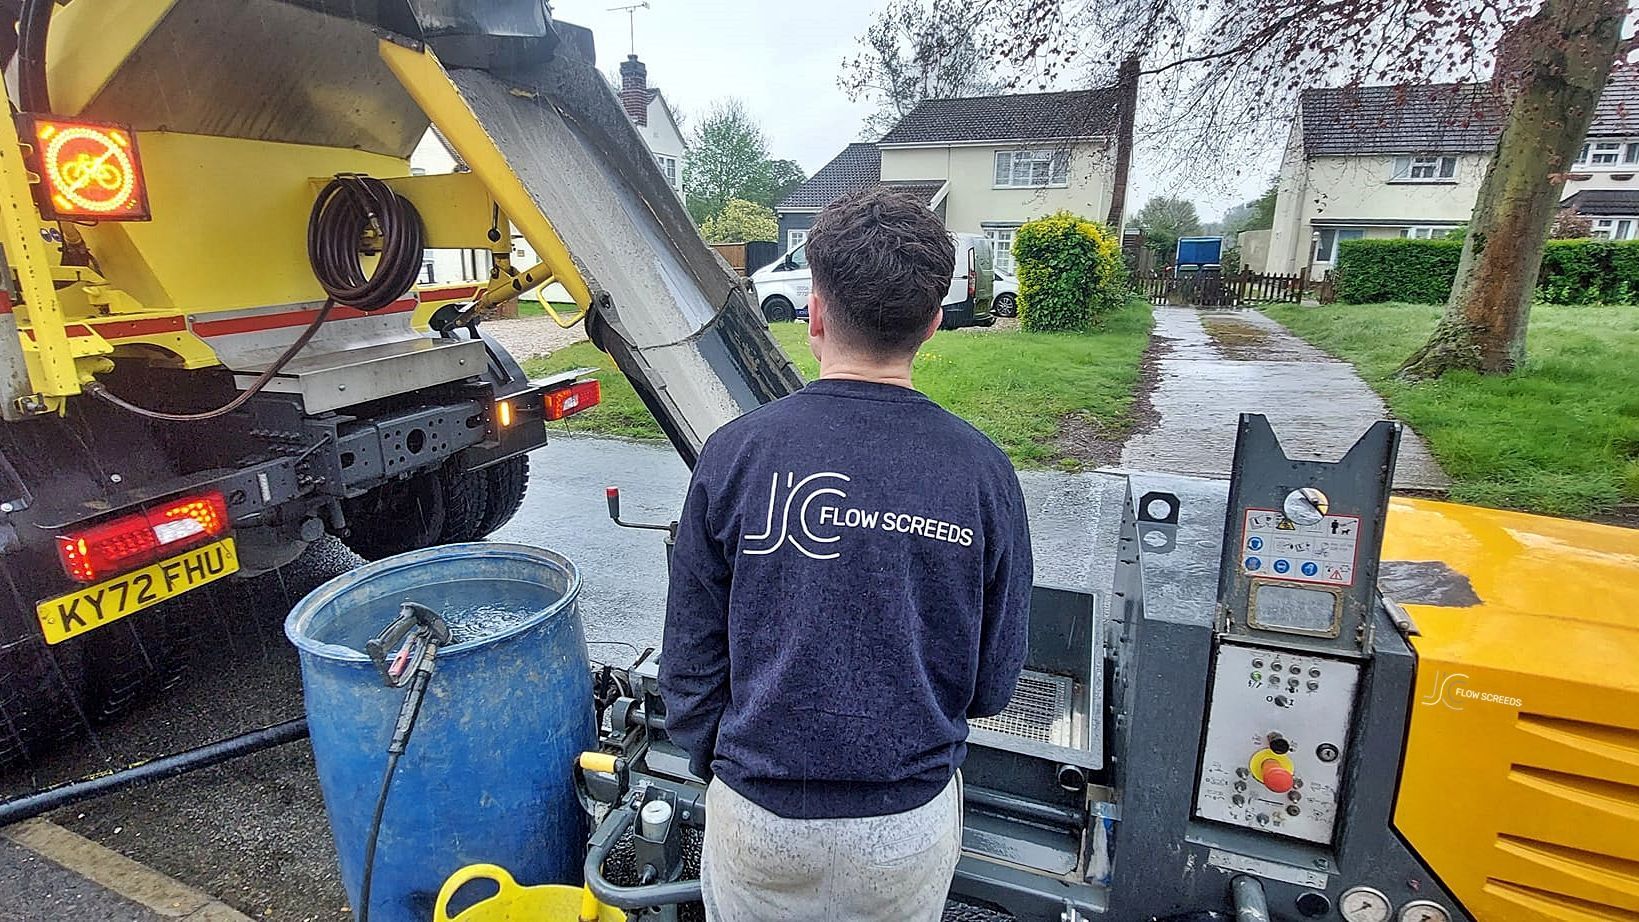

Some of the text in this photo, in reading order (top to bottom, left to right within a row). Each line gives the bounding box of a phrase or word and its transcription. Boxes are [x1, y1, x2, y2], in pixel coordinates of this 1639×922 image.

[820, 506, 880, 529] FLOW
[881, 512, 974, 547] SCREEDS
[58, 547, 225, 633] KY72 FHU
[1455, 687, 1480, 700] FLOW
[1481, 692, 1523, 708] SCREEDS
